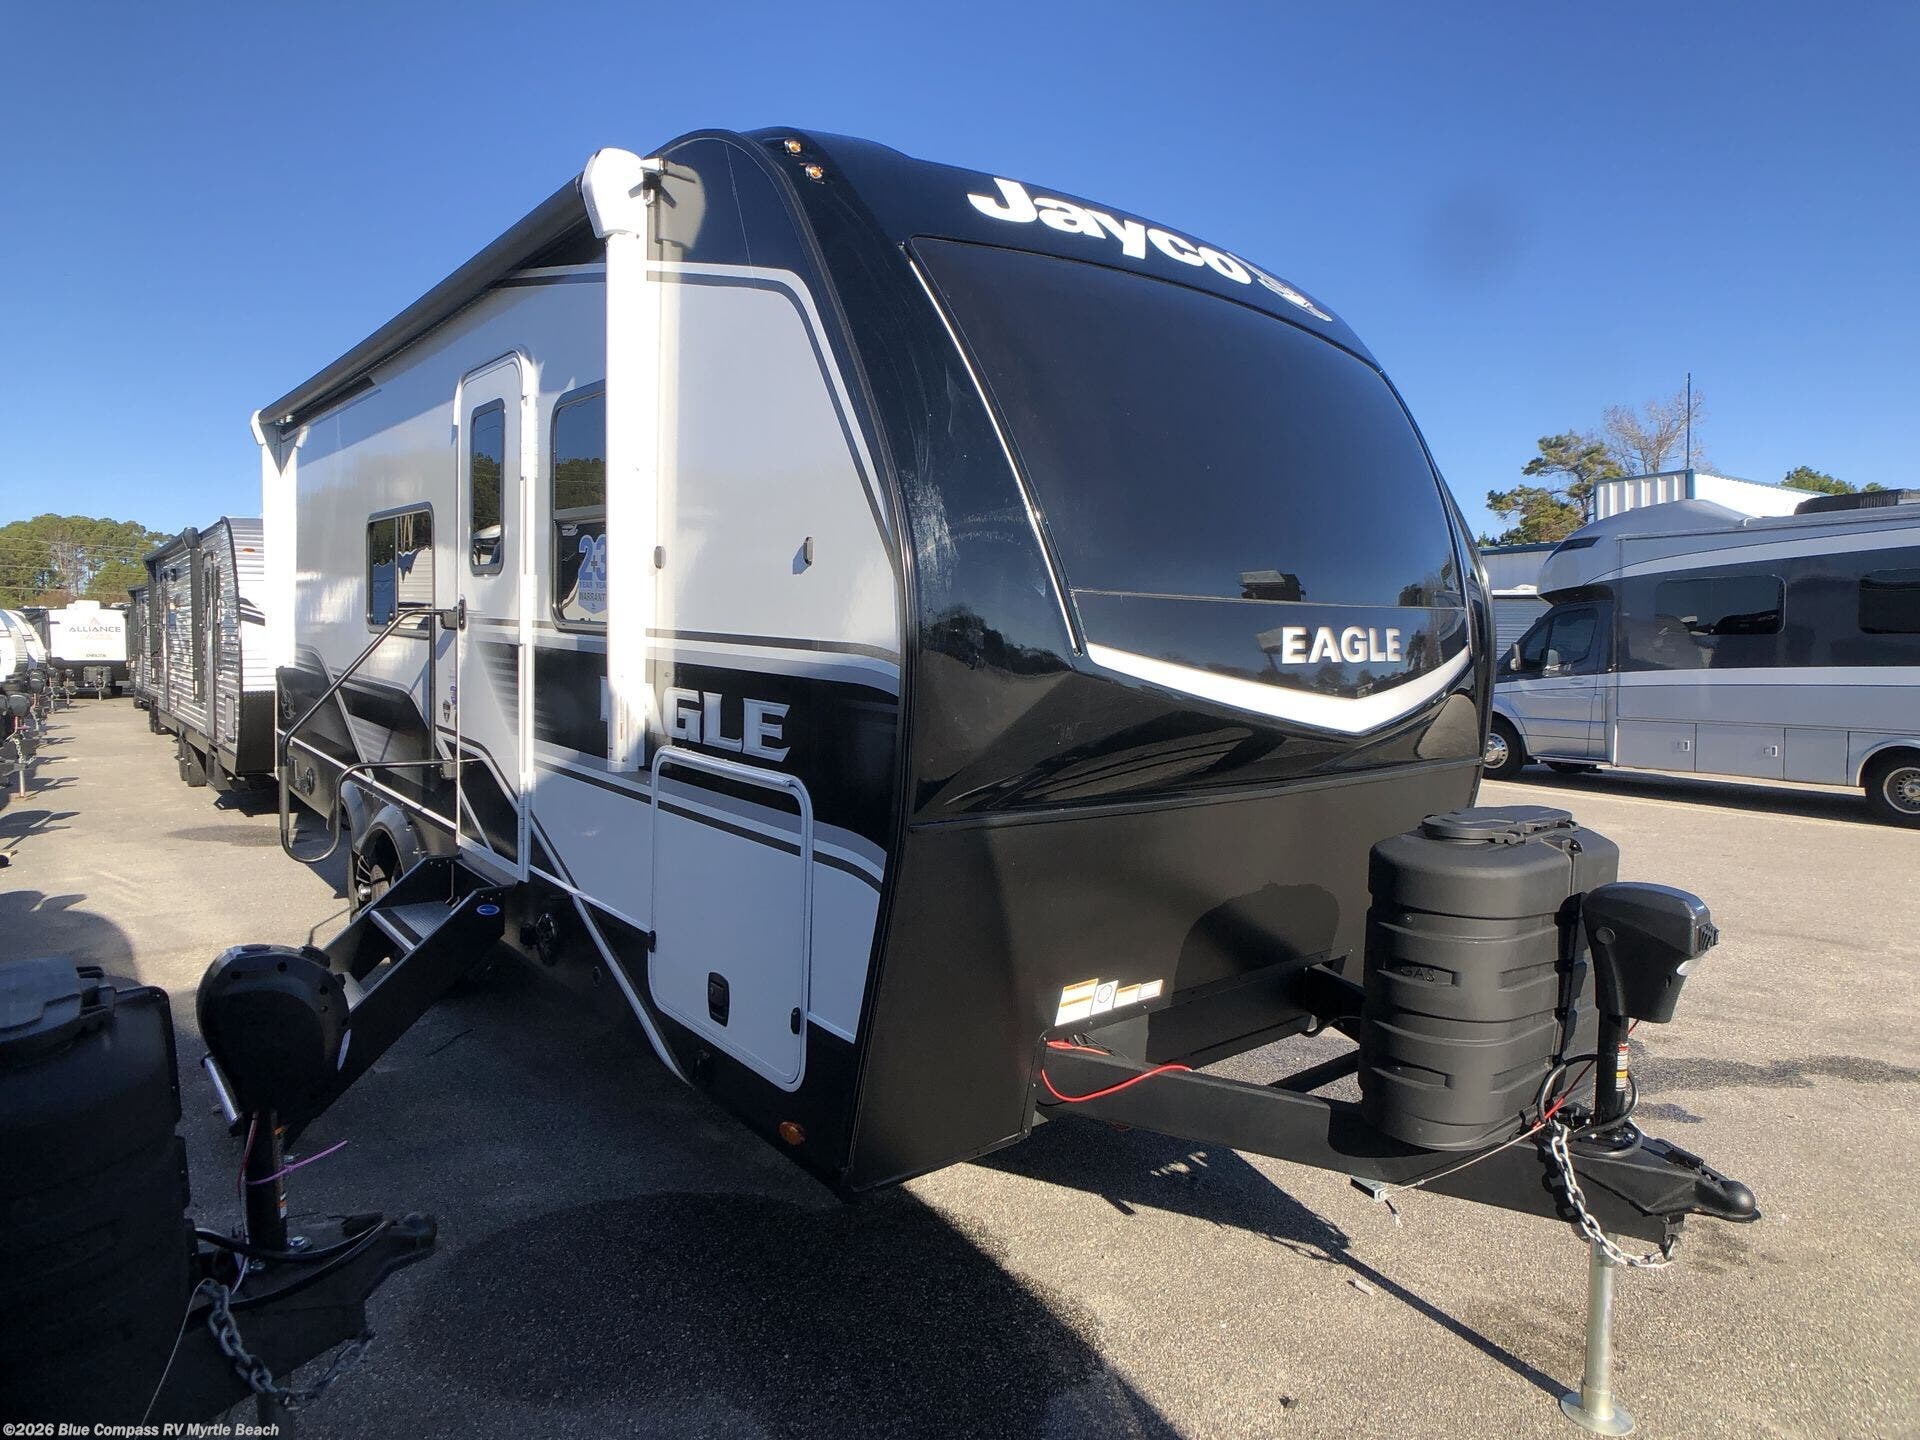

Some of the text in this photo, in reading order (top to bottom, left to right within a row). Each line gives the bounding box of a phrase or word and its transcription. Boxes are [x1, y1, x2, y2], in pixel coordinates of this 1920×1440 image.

[967, 177, 1252, 285] Jayco
[579, 592, 607, 602] WARRANT
[1281, 626, 1402, 665] EAGLE
[1399, 965, 1436, 983] GAS
